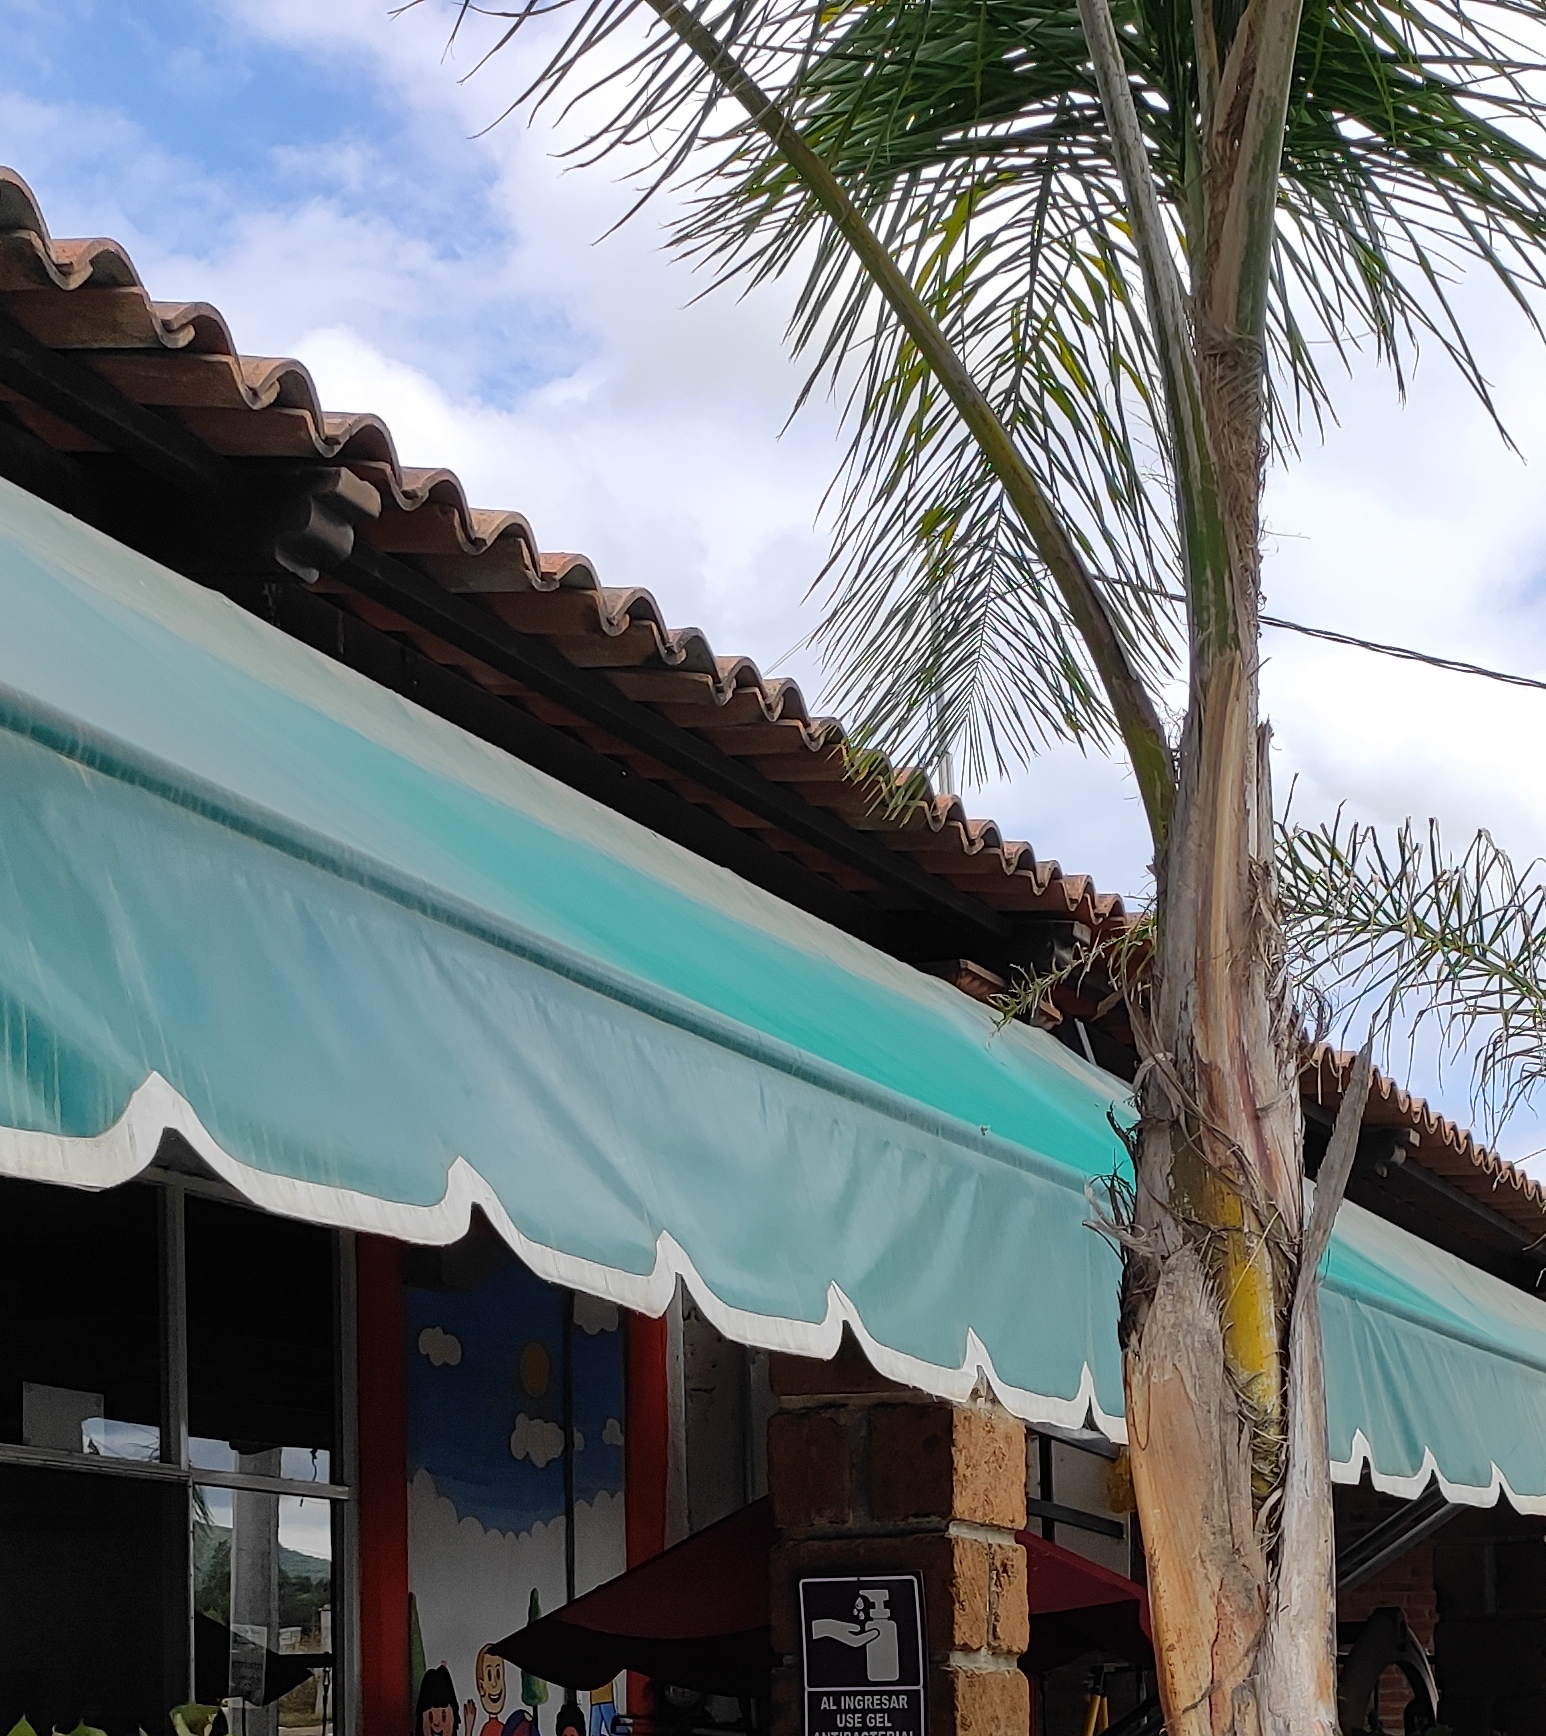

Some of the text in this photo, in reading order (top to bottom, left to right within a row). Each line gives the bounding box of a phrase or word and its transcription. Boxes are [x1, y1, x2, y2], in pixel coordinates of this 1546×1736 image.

[820, 1695, 908, 1710] AL INGRESAR
[836, 1713, 893, 1728] USE GEL
